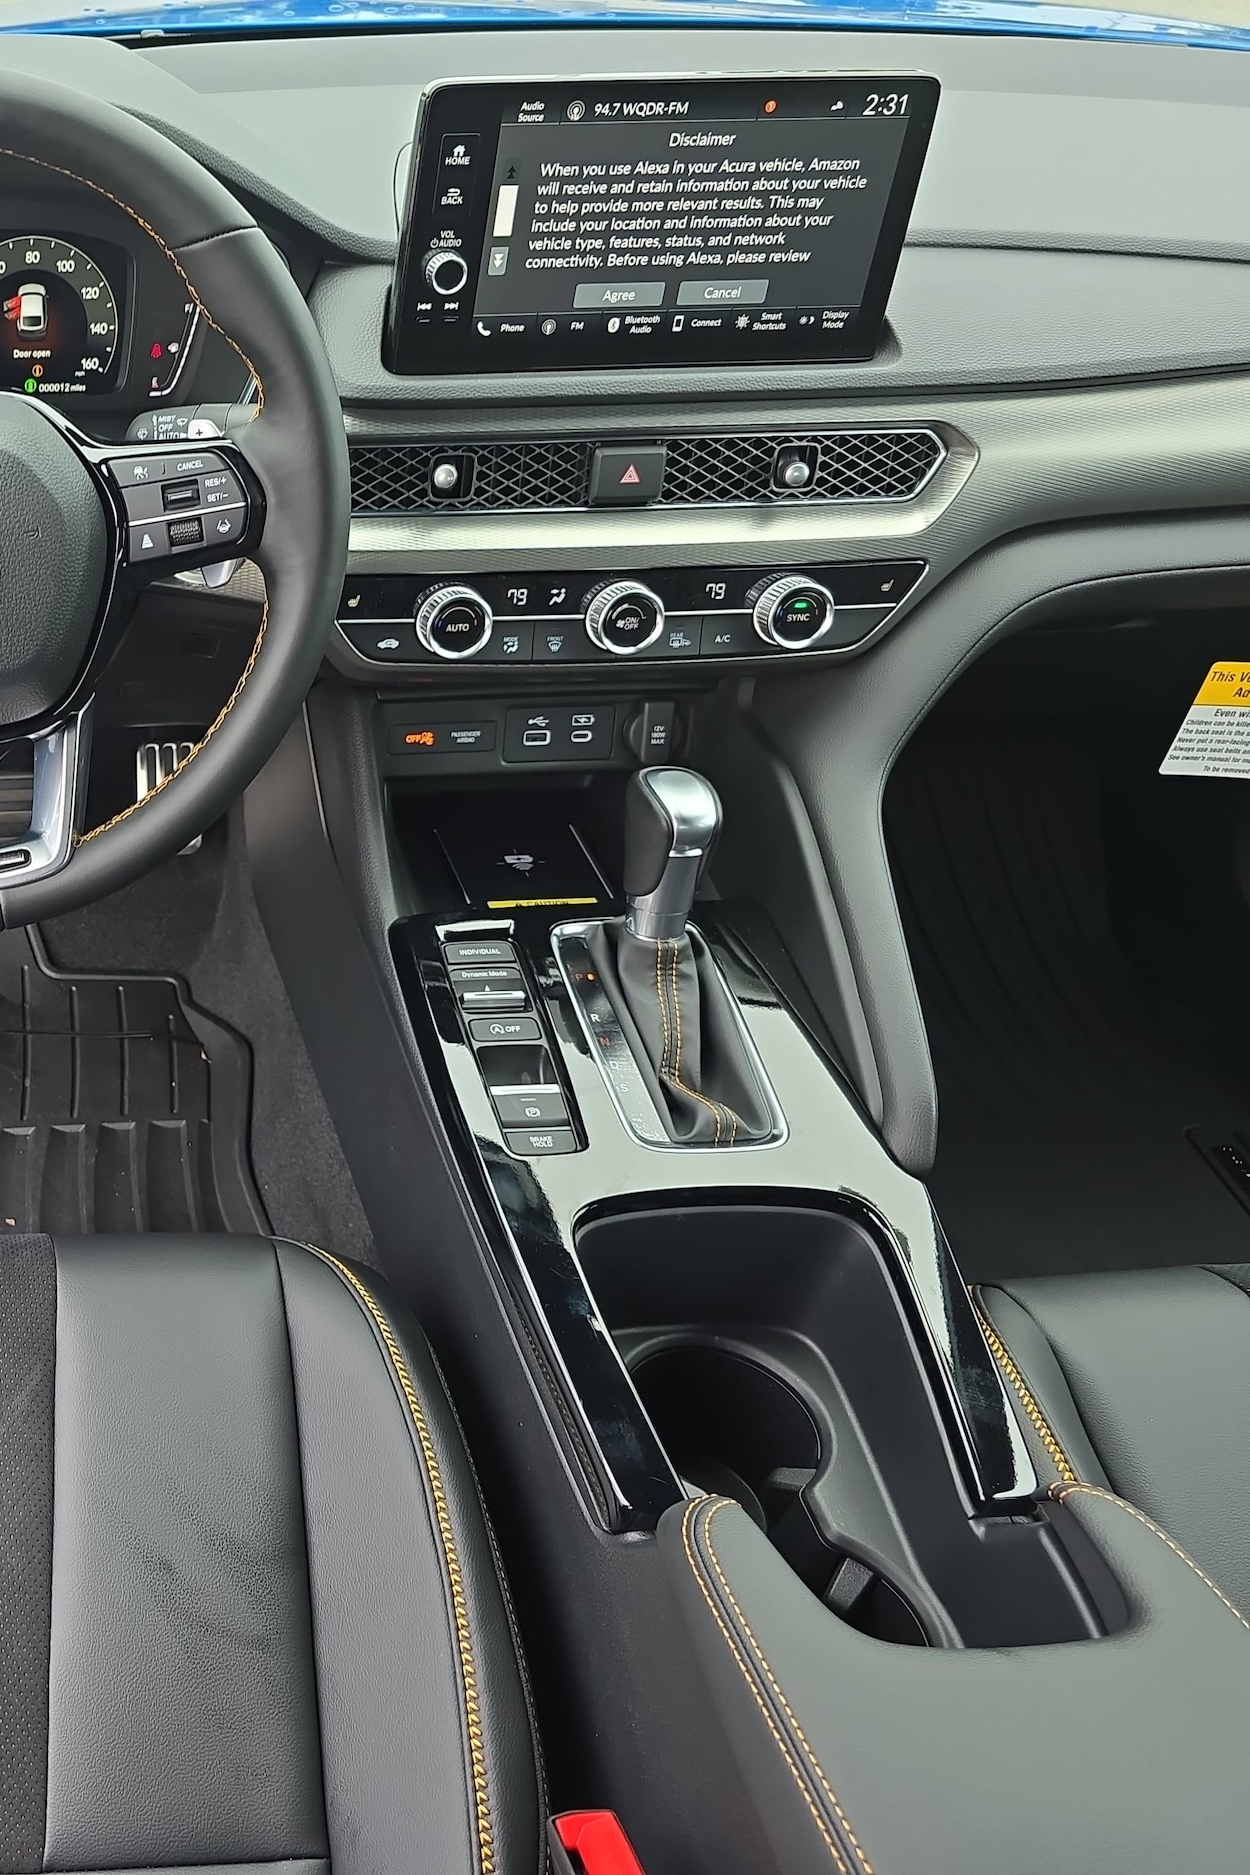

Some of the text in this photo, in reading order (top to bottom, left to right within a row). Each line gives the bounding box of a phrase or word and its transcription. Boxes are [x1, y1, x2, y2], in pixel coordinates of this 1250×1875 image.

[521, 101, 544, 111] Audio
[594, 101, 689, 117] 94.7 WQDR-FM
[862, 94, 908, 116] 2:31
[518, 113, 544, 122] Source
[669, 132, 736, 147] Disclaimer
[445, 156, 470, 165] HOME
[540, 158, 860, 178] When you use Alexa in your Acura vehicle, Amazon
[537, 176, 867, 195] will receive and retain information about your vehicle
[441, 196, 463, 205] BACK
[534, 195, 824, 216] to help provide more relevant results. This may
[531, 214, 834, 233] include your location and information about your
[440, 230, 455, 238] VOL
[439, 238, 462, 247] AUDIO
[528, 232, 786, 251] vehicle type, features, status, and network
[25, 251, 40, 264] 80
[525, 250, 811, 269] connectivity. Before using Alexa, please review
[57, 260, 75, 273] 100
[81, 287, 99, 299] 120
[602, 289, 636, 303] Agree
[704, 286, 741, 299] Cancel
[625, 315, 661, 324] Bluetooth
[761, 312, 783, 320] Smart
[822, 311, 849, 321] Display
[500, 324, 525, 332] Phone
[570, 321, 584, 330] FM
[691, 318, 722, 328] Connect
[752, 322, 787, 331] Shortcuts
[822, 320, 845, 329] Mode
[90, 322, 108, 335] 140
[629, 325, 652, 334] Audio
[13, 350, 51, 359] Door open
[81, 358, 99, 370] 160
[39, 383, 86, 392] 000012 miles
[158, 424, 173, 432] OFF
[177, 460, 203, 471] CANCEL
[706, 583, 725, 599] 79
[508, 588, 527, 605] 79
[786, 613, 811, 622] SYNC
[446, 624, 469, 632] AUTO
[715, 635, 731, 643] A/C
[1210, 671, 1236, 682] This
[1214, 709, 1236, 717] Even
[406, 735, 421, 743] OFF
[590, 1014, 600, 1022] R
[600, 1038, 611, 1046] N
